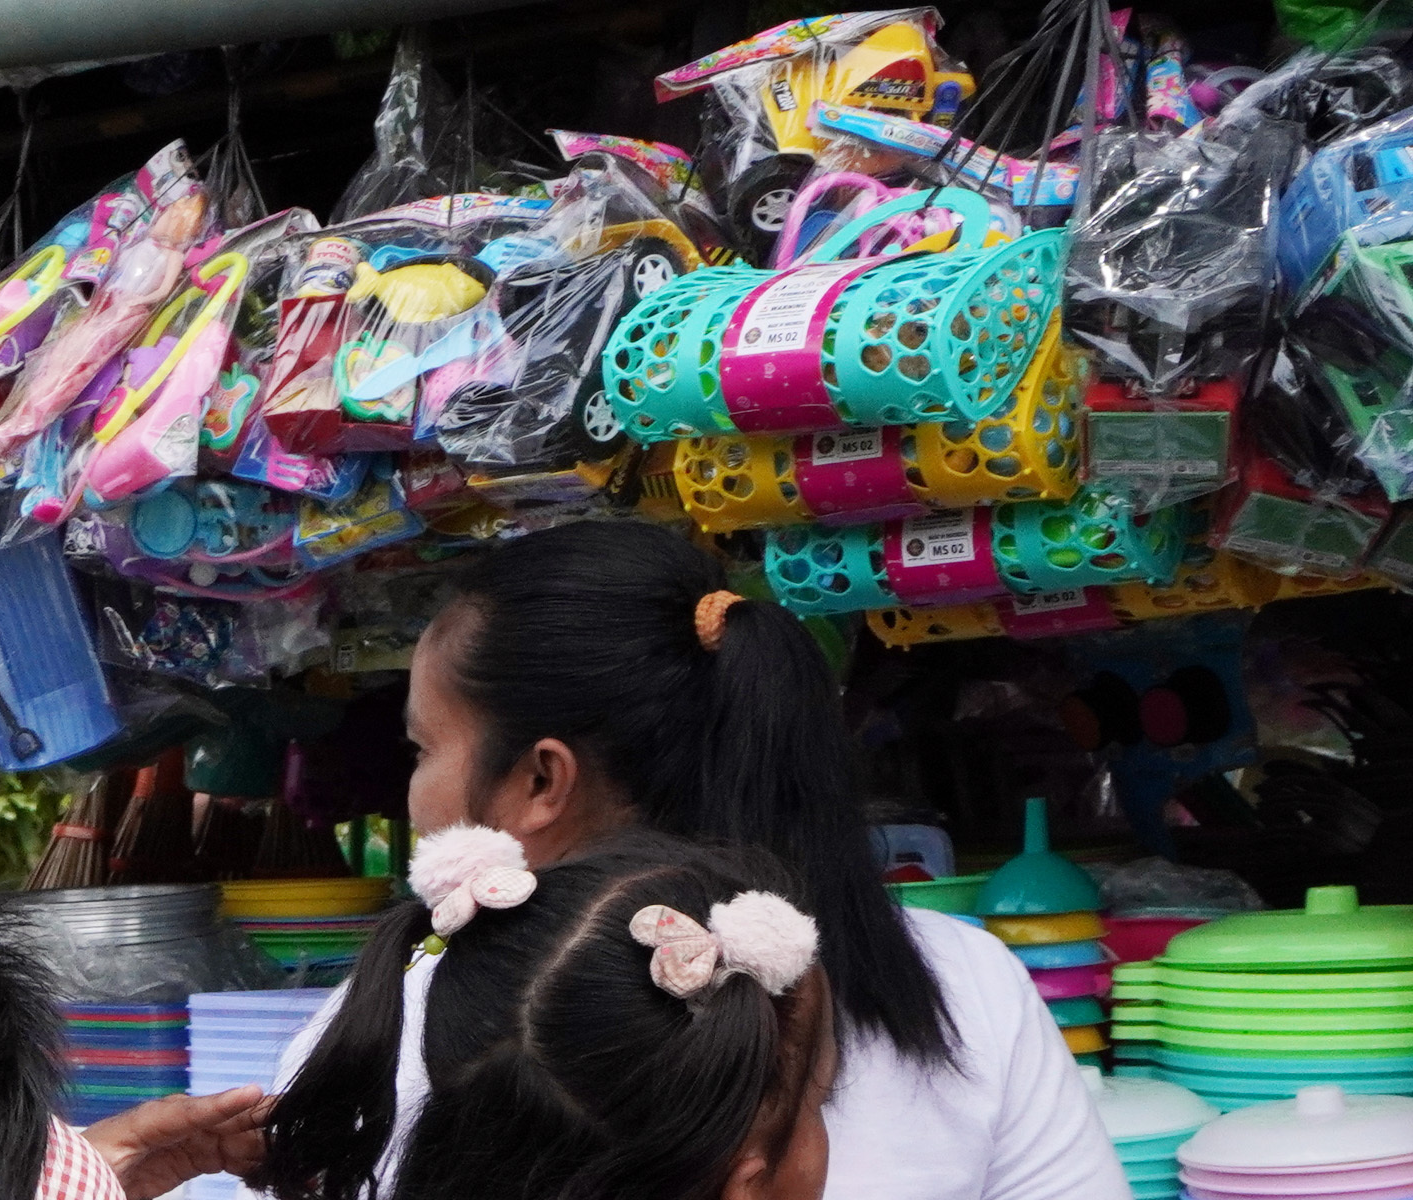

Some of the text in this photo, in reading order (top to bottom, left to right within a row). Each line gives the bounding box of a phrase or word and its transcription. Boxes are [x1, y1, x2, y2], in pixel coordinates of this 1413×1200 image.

[767, 331, 798, 344] MS 02
[842, 440, 873, 453] MS 02
[933, 543, 965, 556] MS 02
[1043, 590, 1076, 603] MS 02
